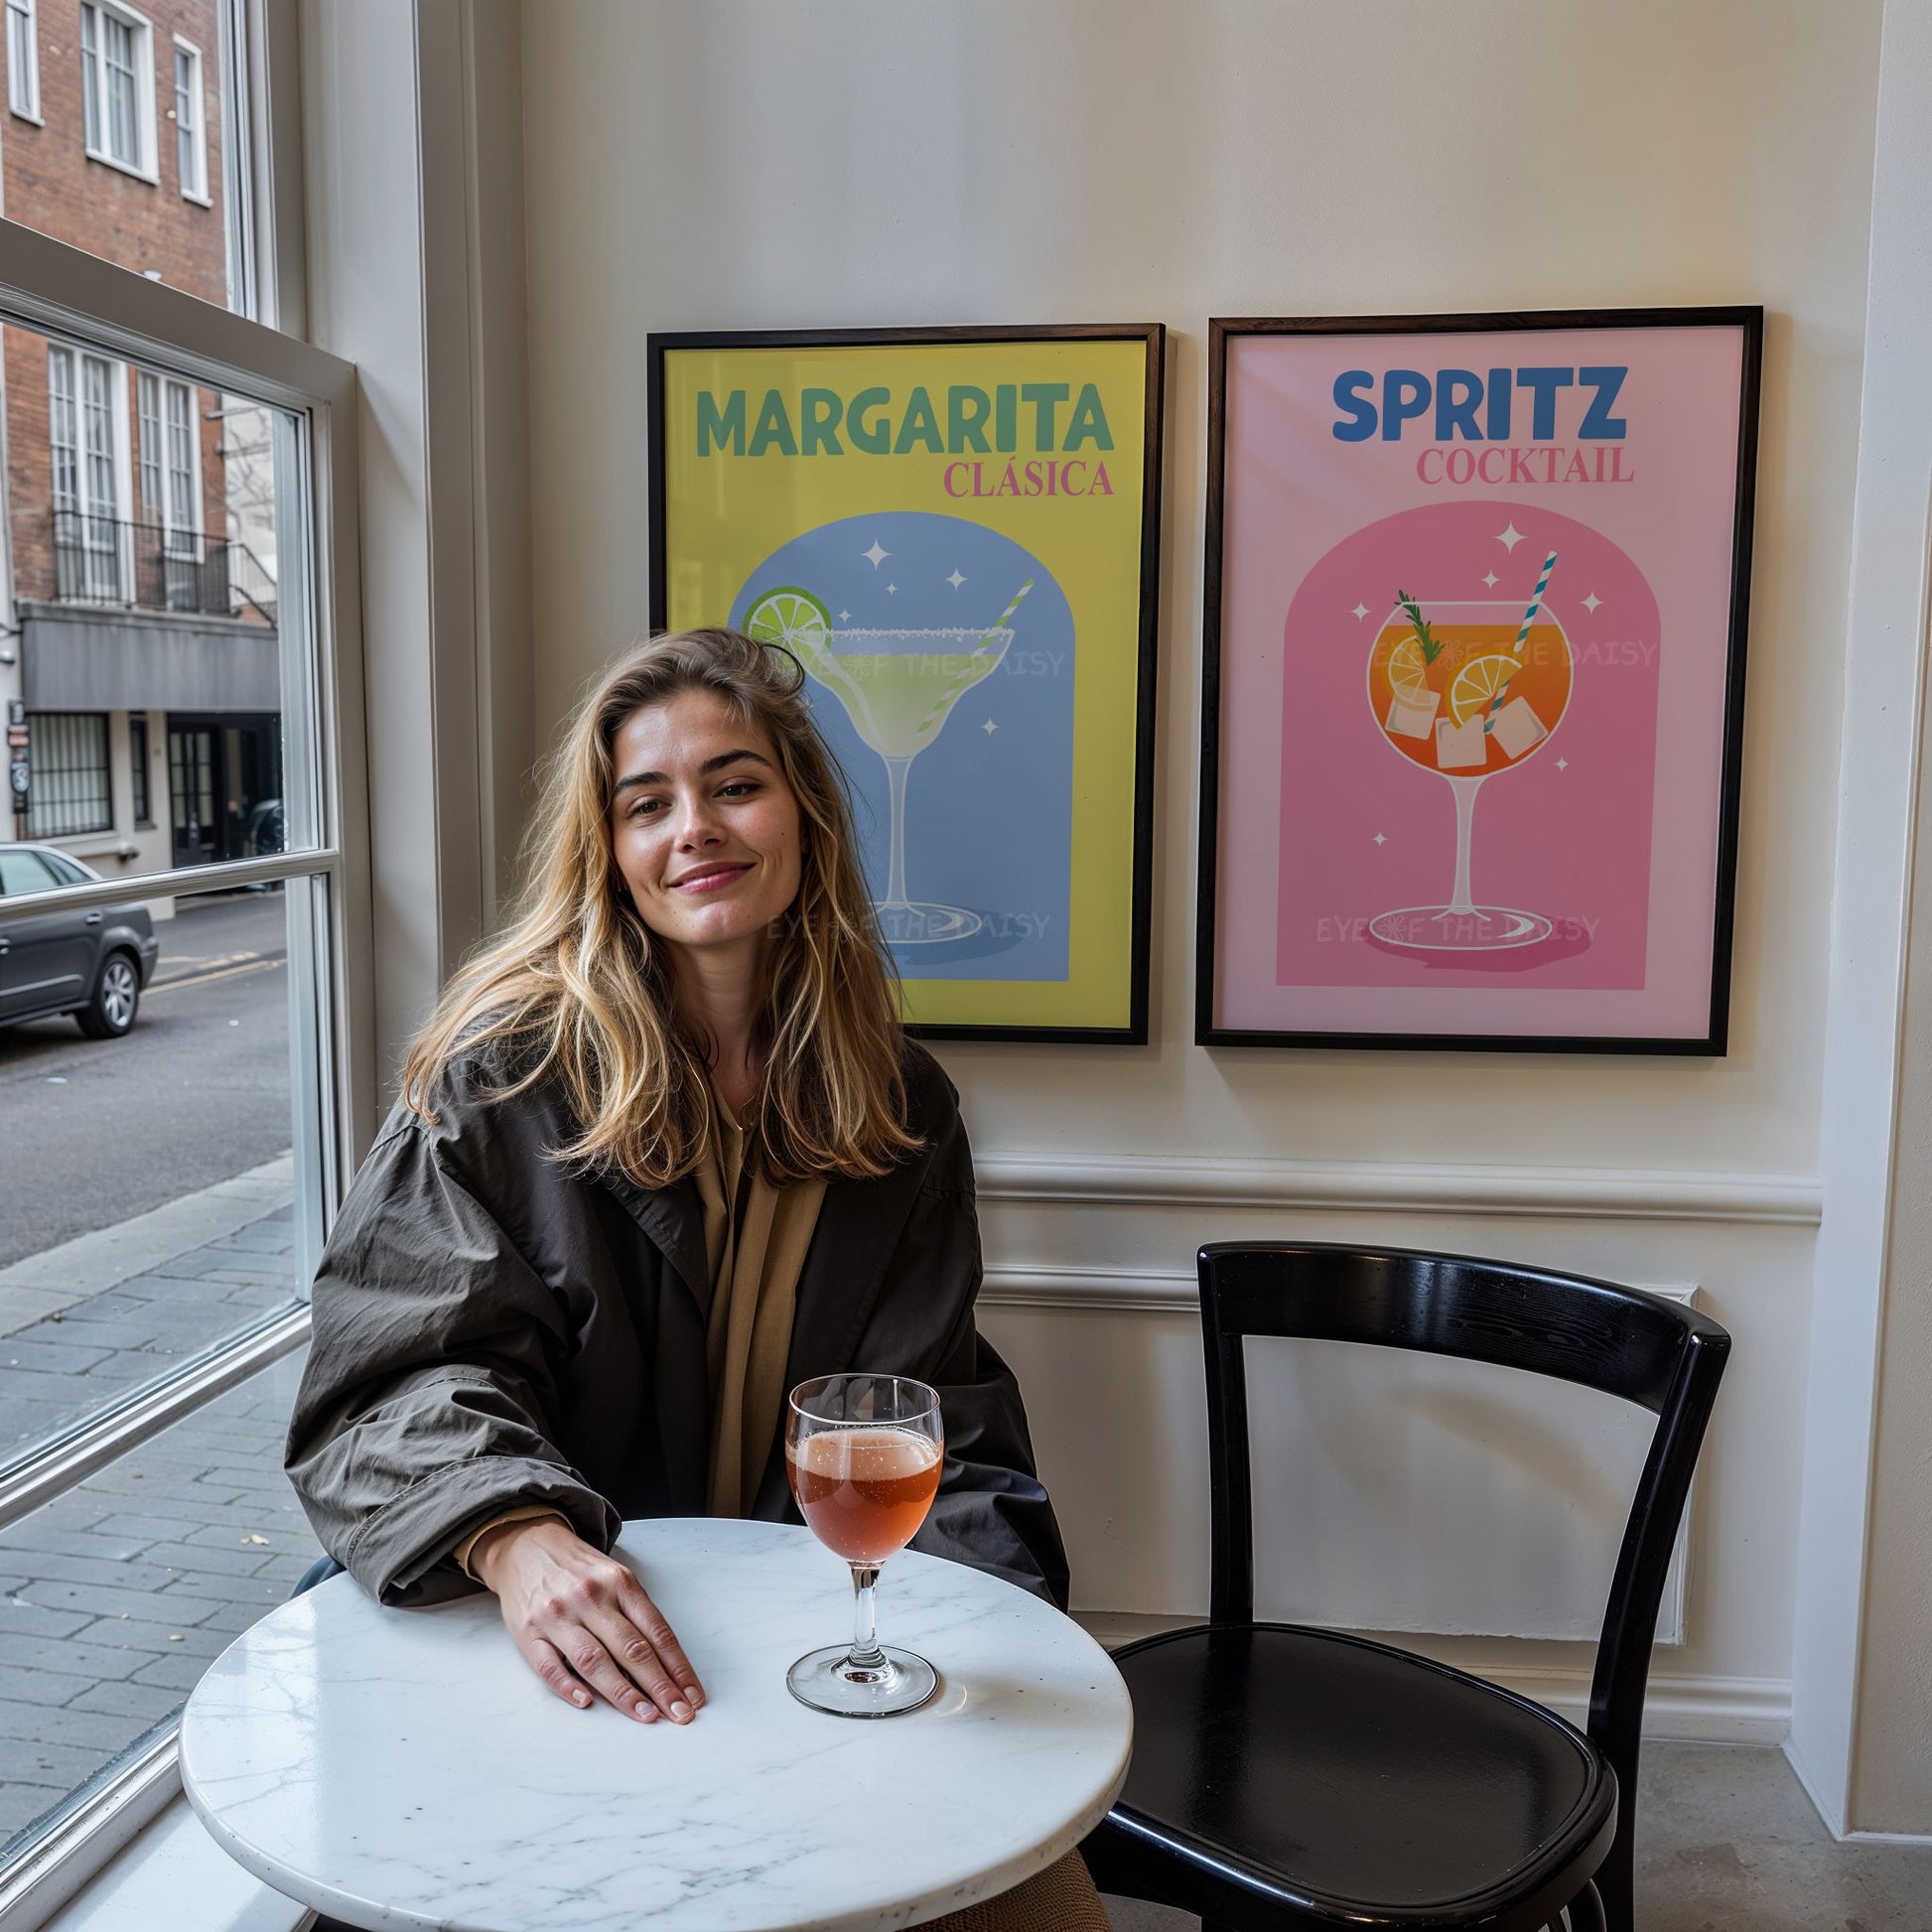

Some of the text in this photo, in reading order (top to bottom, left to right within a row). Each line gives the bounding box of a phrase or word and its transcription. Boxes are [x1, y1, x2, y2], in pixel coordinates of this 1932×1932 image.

[697, 382, 1115, 458] MARGARITA
[1333, 366, 1628, 443] SPRITZ
[944, 456, 1114, 497] CLÁSICA
[1416, 447, 1634, 484] COCKTAIL
